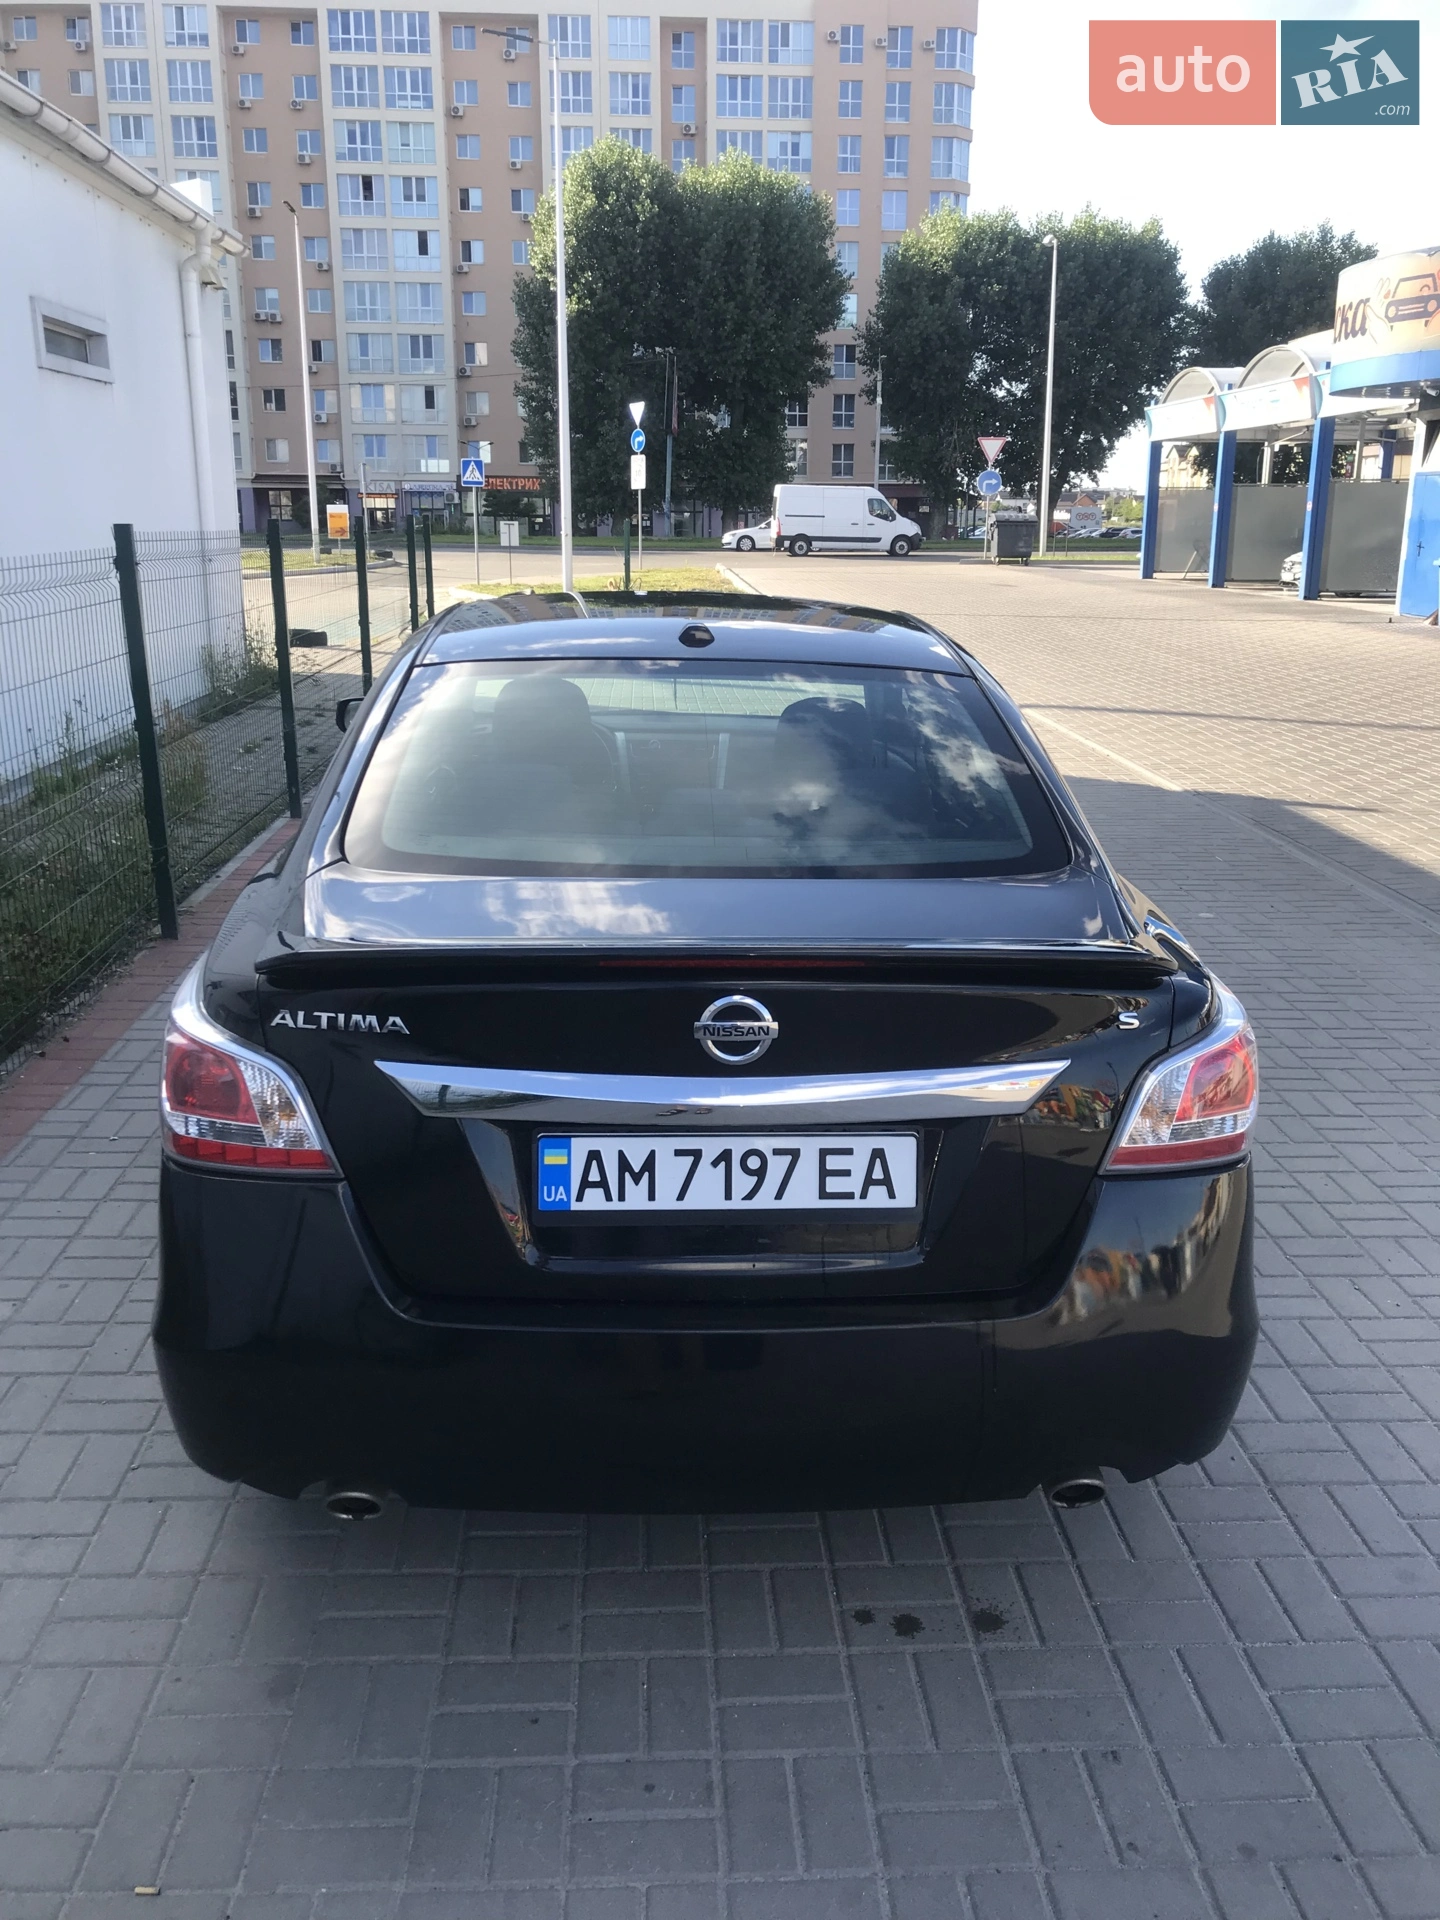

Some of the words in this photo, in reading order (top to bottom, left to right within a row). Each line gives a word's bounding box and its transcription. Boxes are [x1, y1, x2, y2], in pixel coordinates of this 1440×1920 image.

[270, 1009, 411, 1035] ALTIMA
[1119, 1012, 1140, 1029] S
[702, 1025, 770, 1037] NISSAN
[575, 1149, 656, 1202] AM
[673, 1148, 801, 1201] 7197
[818, 1147, 897, 1200] EA
[543, 1185, 568, 1202] UA
